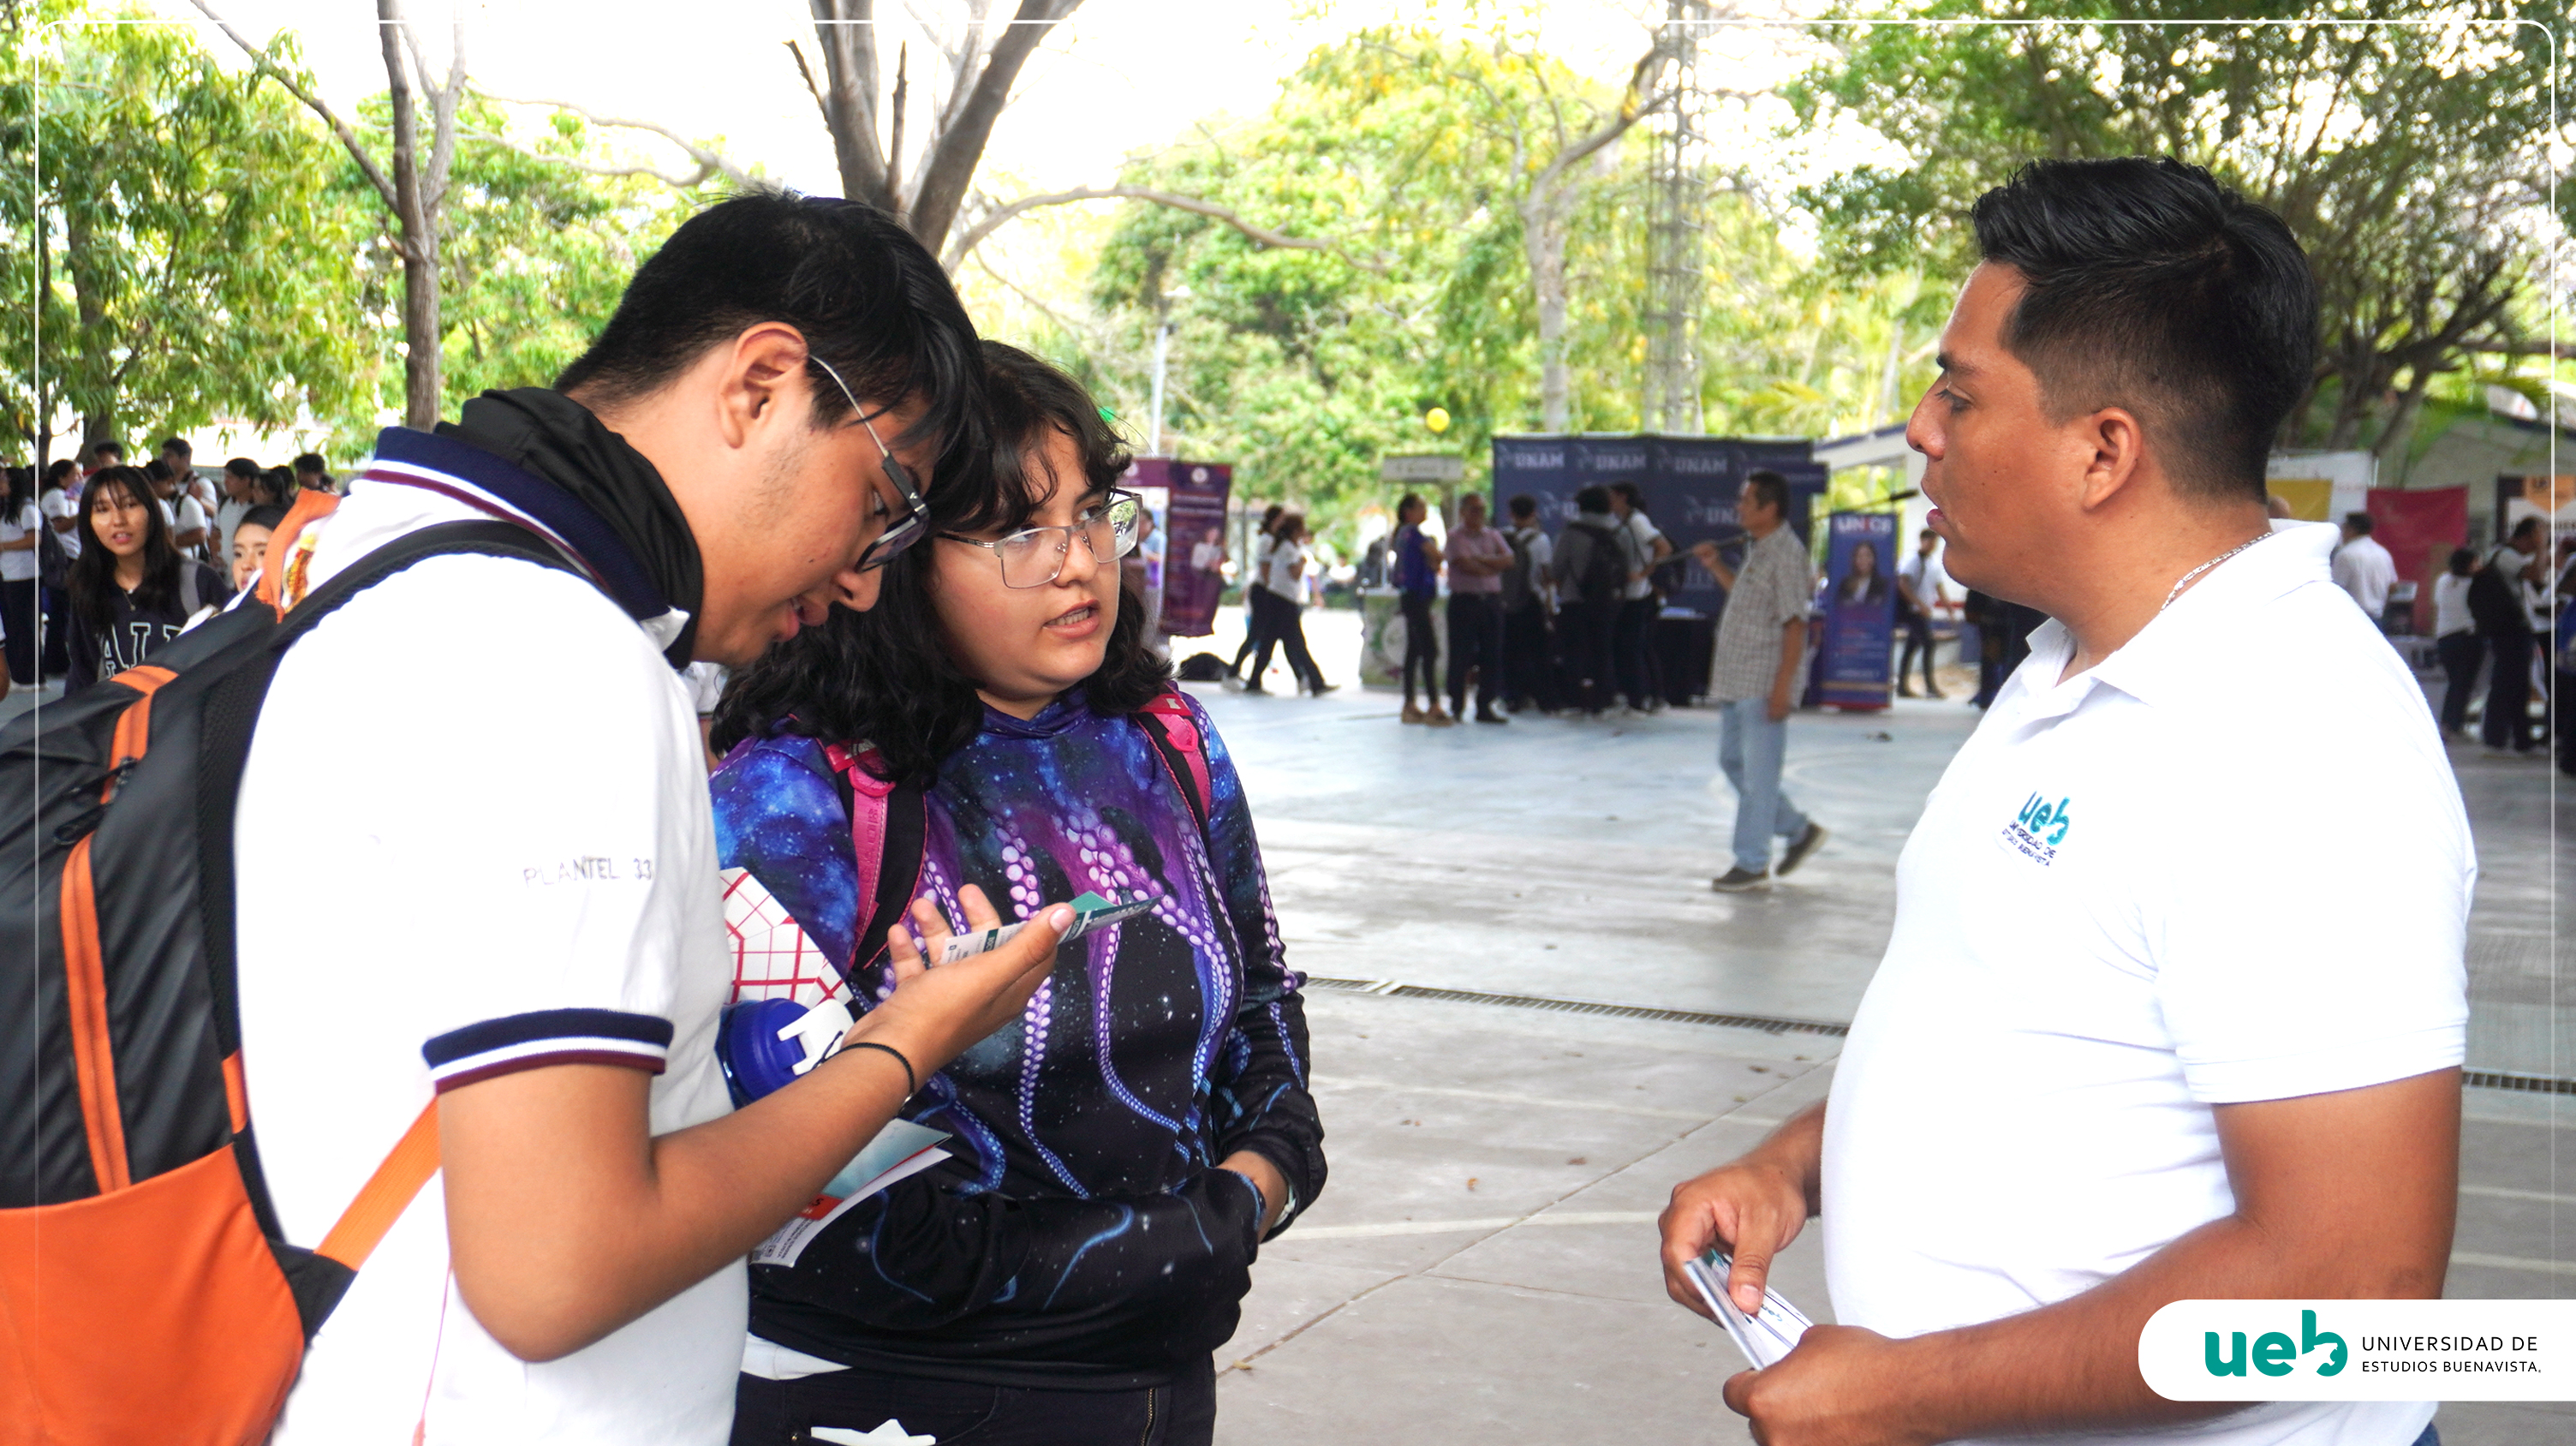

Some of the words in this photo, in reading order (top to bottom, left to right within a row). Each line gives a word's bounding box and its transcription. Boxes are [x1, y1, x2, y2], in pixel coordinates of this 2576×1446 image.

[1514, 451, 1565, 469] UNAM
[523, 855, 621, 887] PLANTEL
[633, 857, 652, 881] 33
